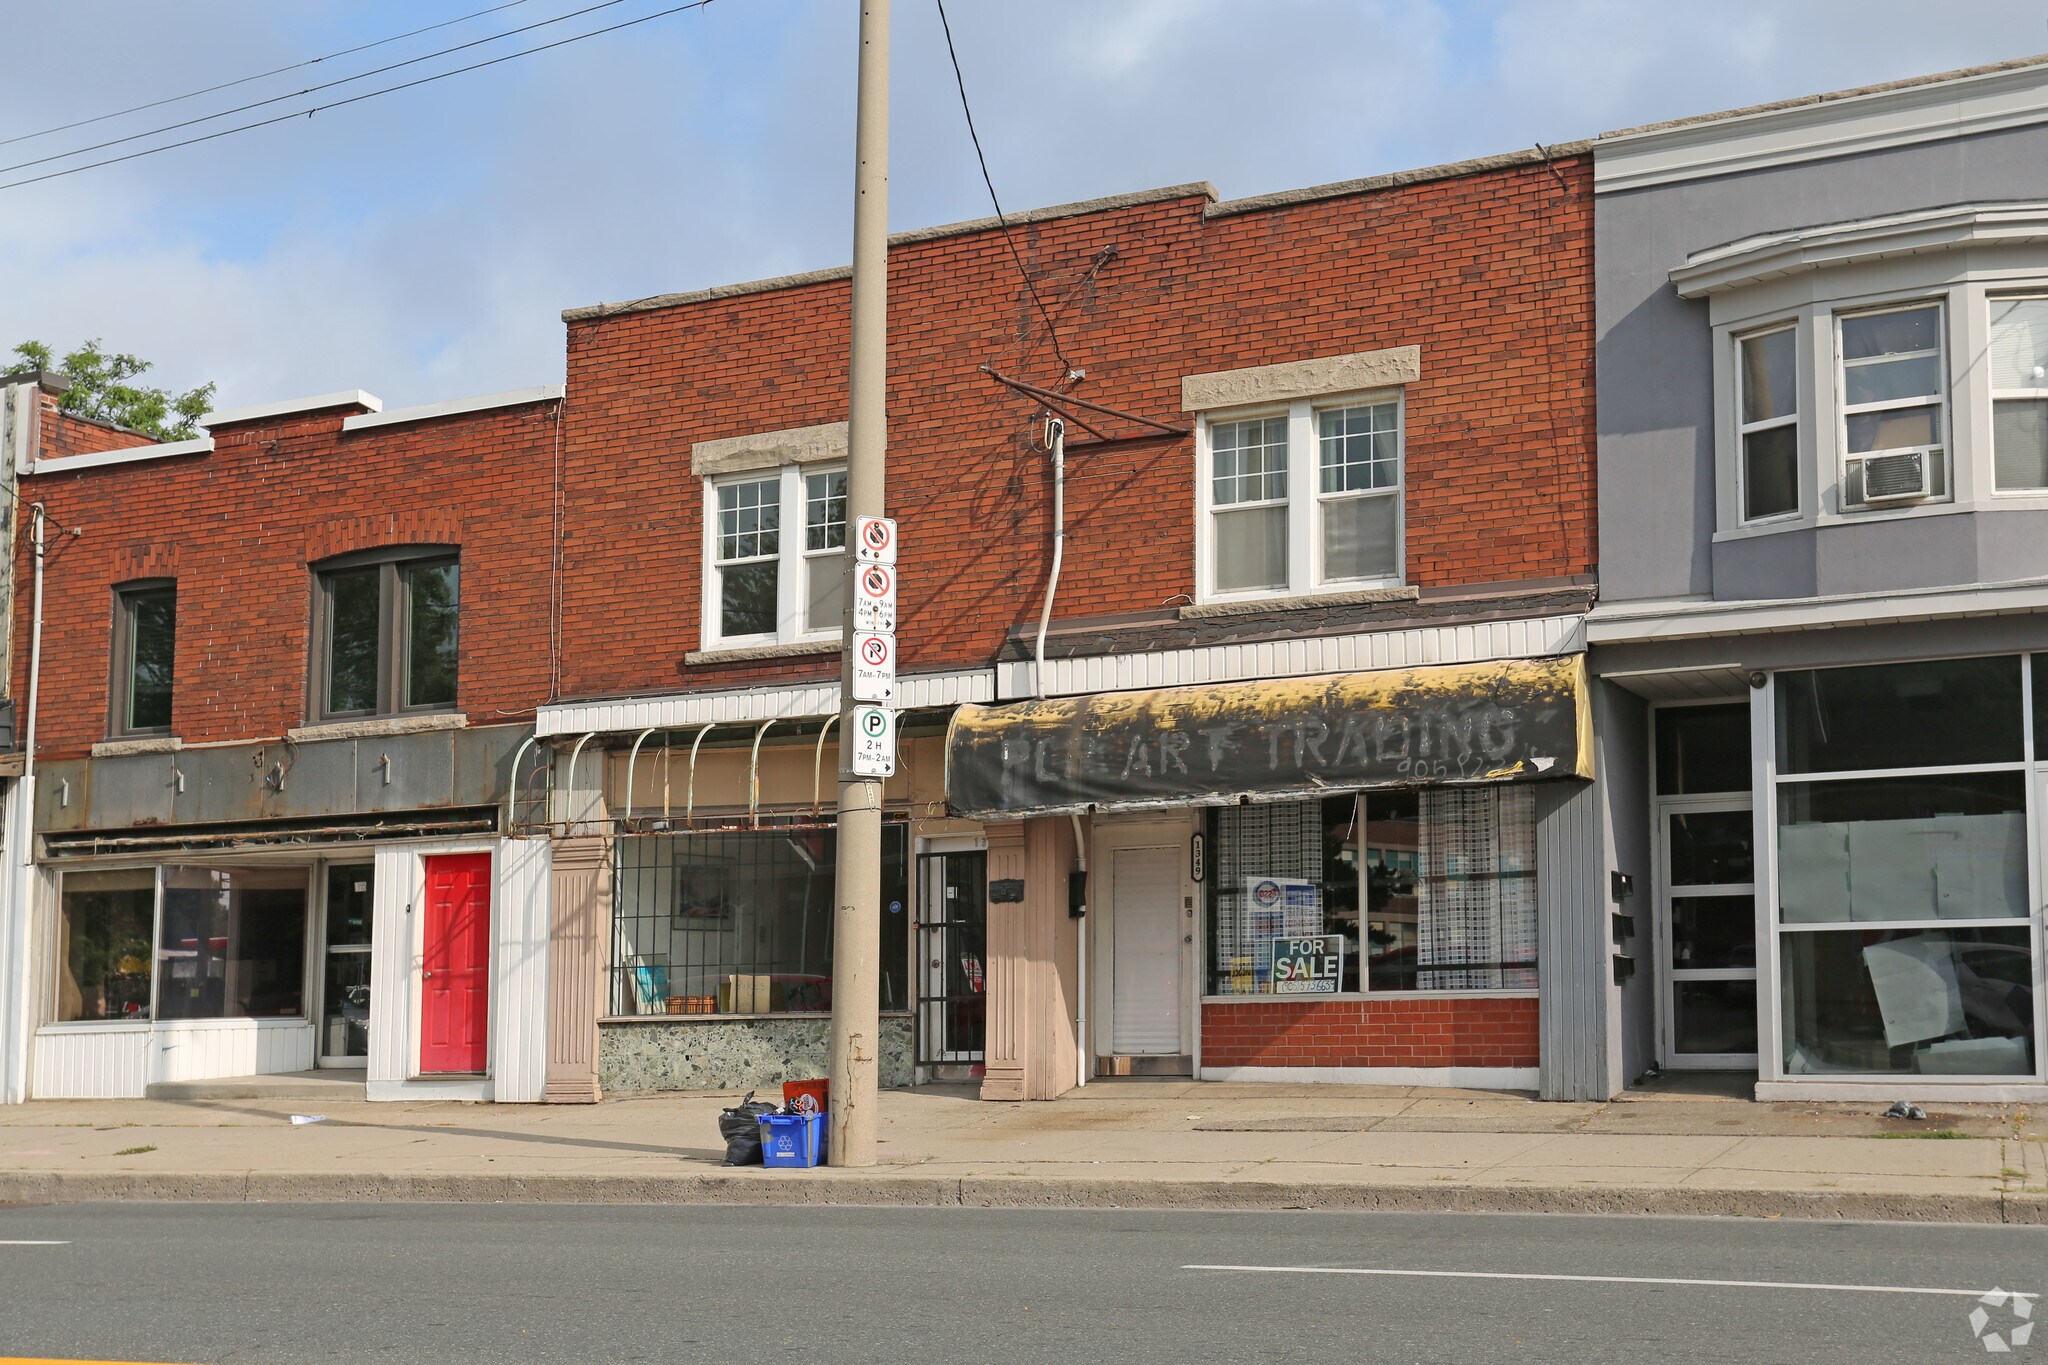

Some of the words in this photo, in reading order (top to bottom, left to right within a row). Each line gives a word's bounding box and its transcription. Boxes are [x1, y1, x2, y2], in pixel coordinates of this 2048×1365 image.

[858, 608, 872, 616] 4PM
[879, 610, 893, 618] 6PM
[869, 715, 881, 732] P
[866, 739, 873, 750] 2
[875, 741, 882, 750] H
[1255, 708, 1517, 770] TRADING
[1289, 939, 1325, 956] FOR
[1275, 956, 1338, 979] SALE
